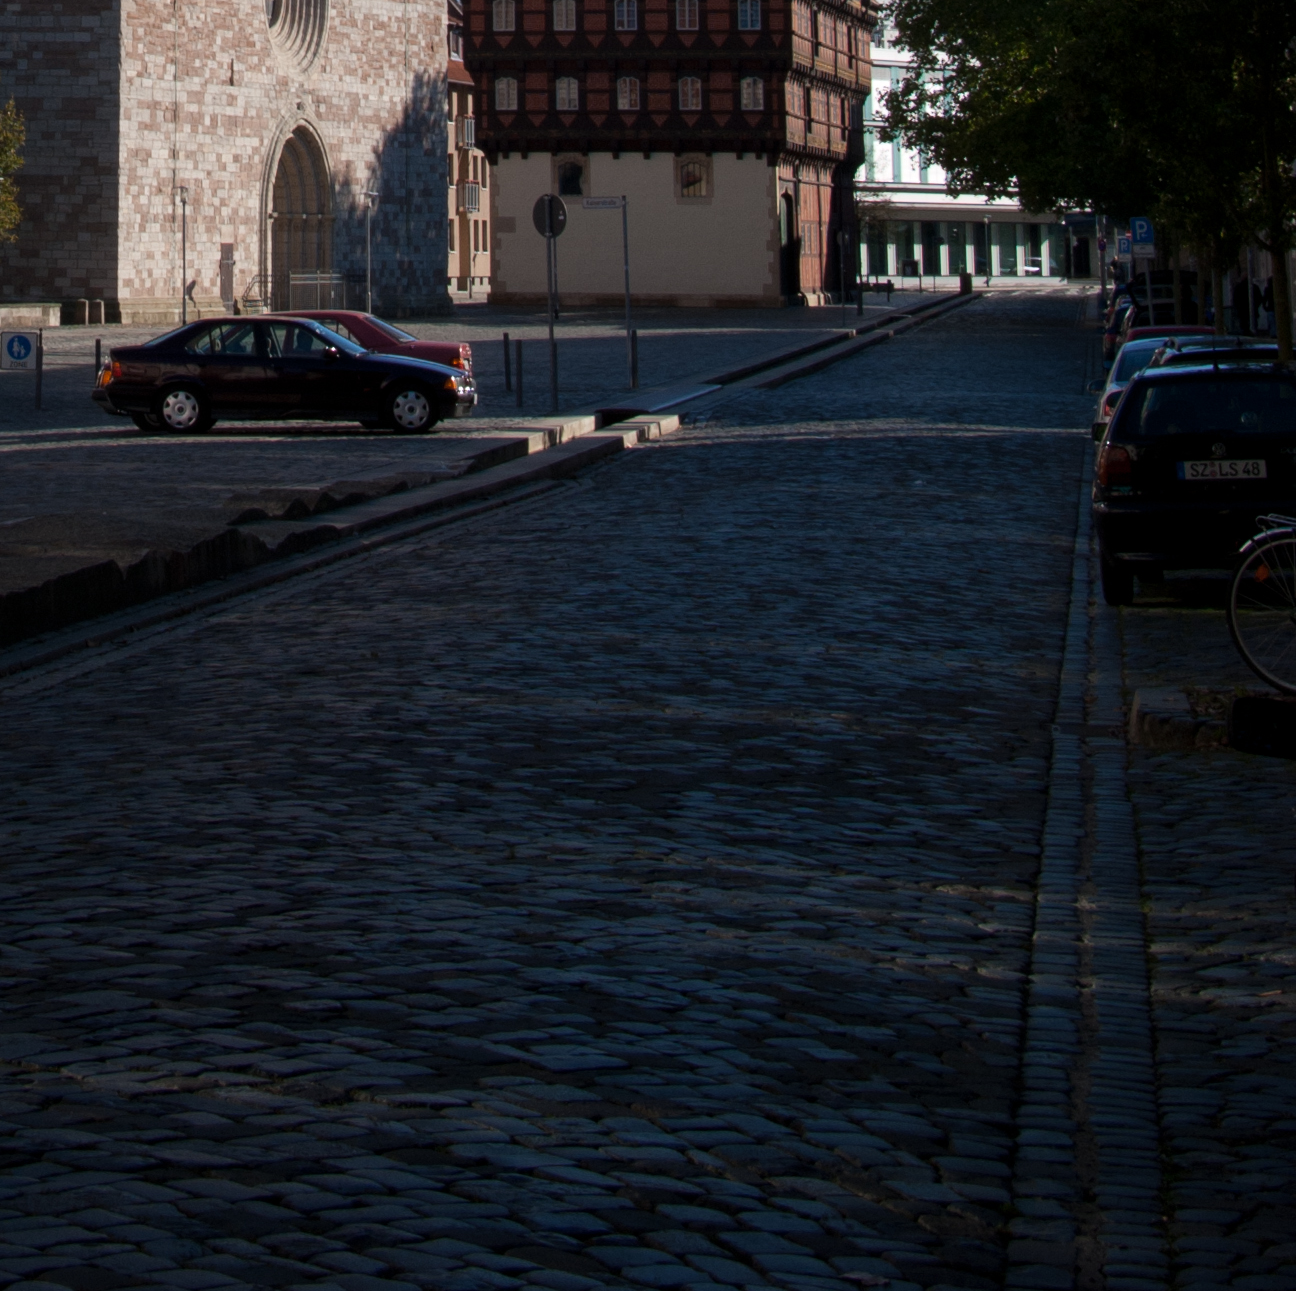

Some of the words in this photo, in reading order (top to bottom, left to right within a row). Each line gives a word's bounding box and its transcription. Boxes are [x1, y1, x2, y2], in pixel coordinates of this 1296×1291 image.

[1136, 221, 1148, 241] P
[1190, 463, 1209, 477] SZ
[1218, 462, 1238, 477] LS
[1242, 462, 1260, 476] 48
